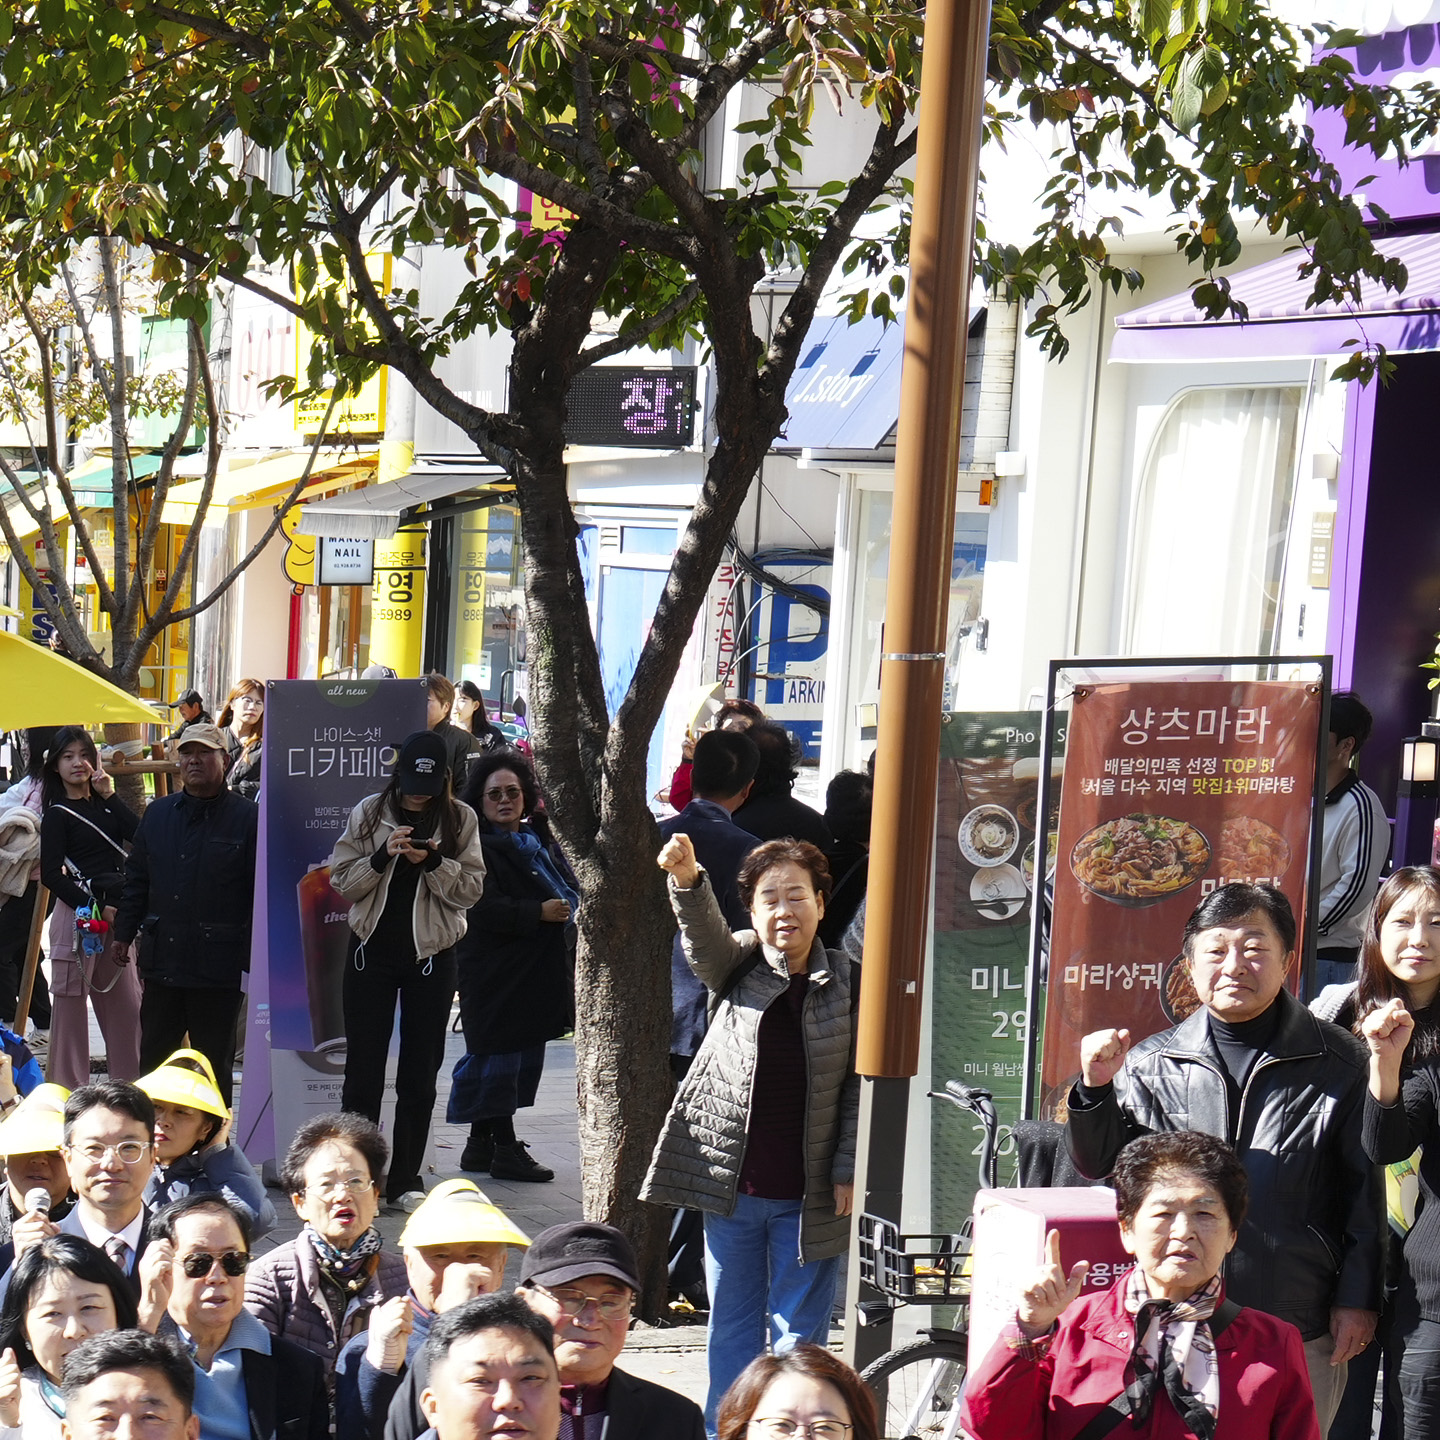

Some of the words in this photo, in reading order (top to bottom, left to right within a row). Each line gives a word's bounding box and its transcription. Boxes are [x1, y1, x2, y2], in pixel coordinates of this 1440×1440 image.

[334, 548, 362, 558] NAIL
[327, 685, 344, 696] all
[346, 688, 368, 696] new
[1120, 705, 1272, 747] 샹츠마라
[1005, 729, 1035, 746] Pho
[1104, 757, 1180, 776] 배달의민족
[1186, 757, 1217, 775] 선정
[1222, 758, 1257, 775] TOP
[1120, 777, 1151, 796] 다수
[1156, 777, 1186, 795] 지역
[323, 911, 348, 924] the
[963, 1062, 988, 1076] 미니
